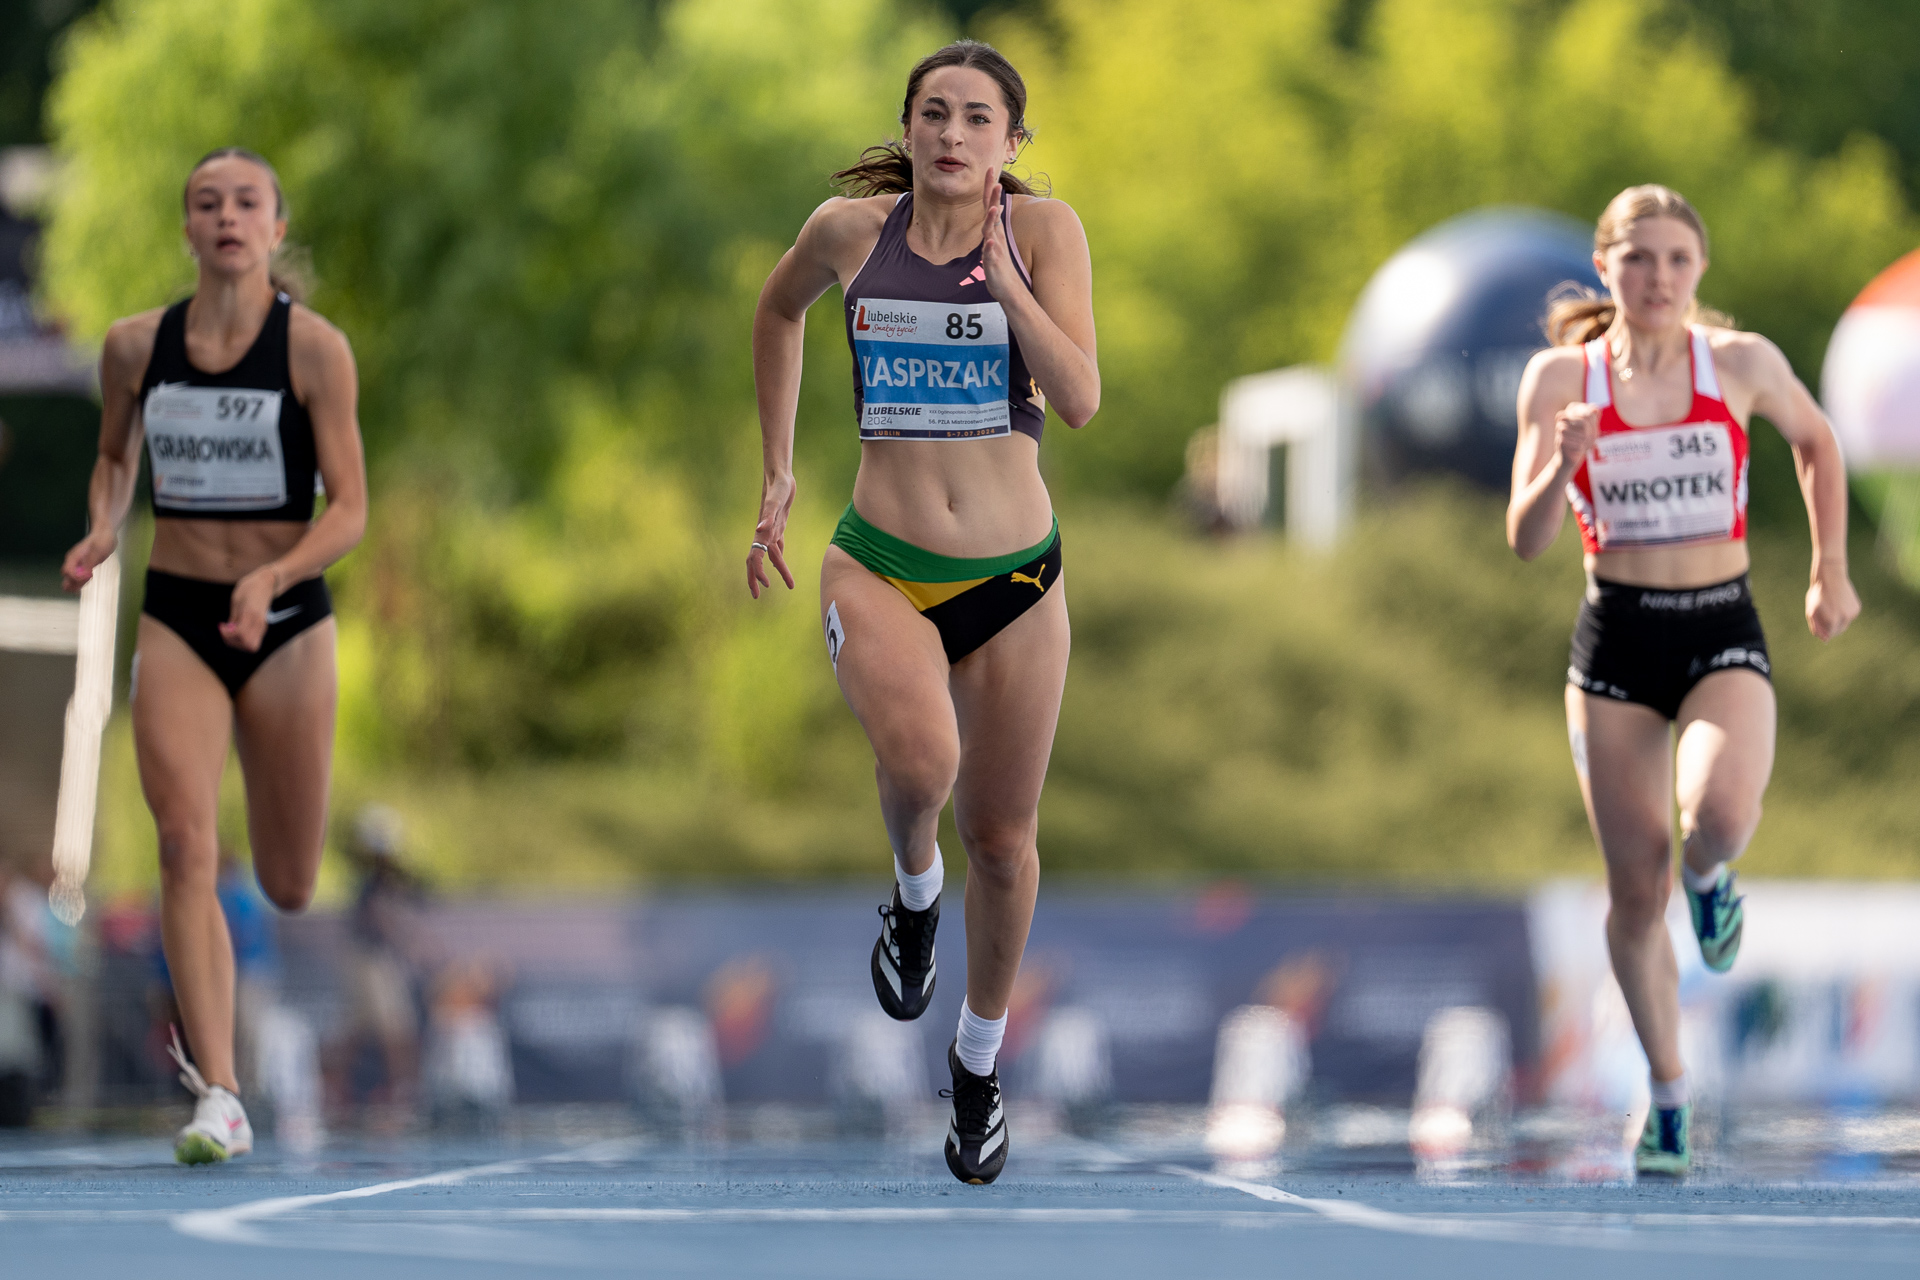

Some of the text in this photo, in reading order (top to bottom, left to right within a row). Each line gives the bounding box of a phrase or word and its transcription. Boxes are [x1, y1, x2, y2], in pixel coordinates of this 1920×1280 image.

[945, 312, 983, 340] 85
[217, 394, 264, 421] 597
[867, 416, 893, 425] 2024
[868, 406, 922, 416] LUBELSKIE
[154, 433, 274, 463] GRABOWSKA
[1669, 432, 1718, 459] 345
[1600, 470, 1726, 504] WROTEK
[1639, 582, 1742, 611] NIKE PRO
